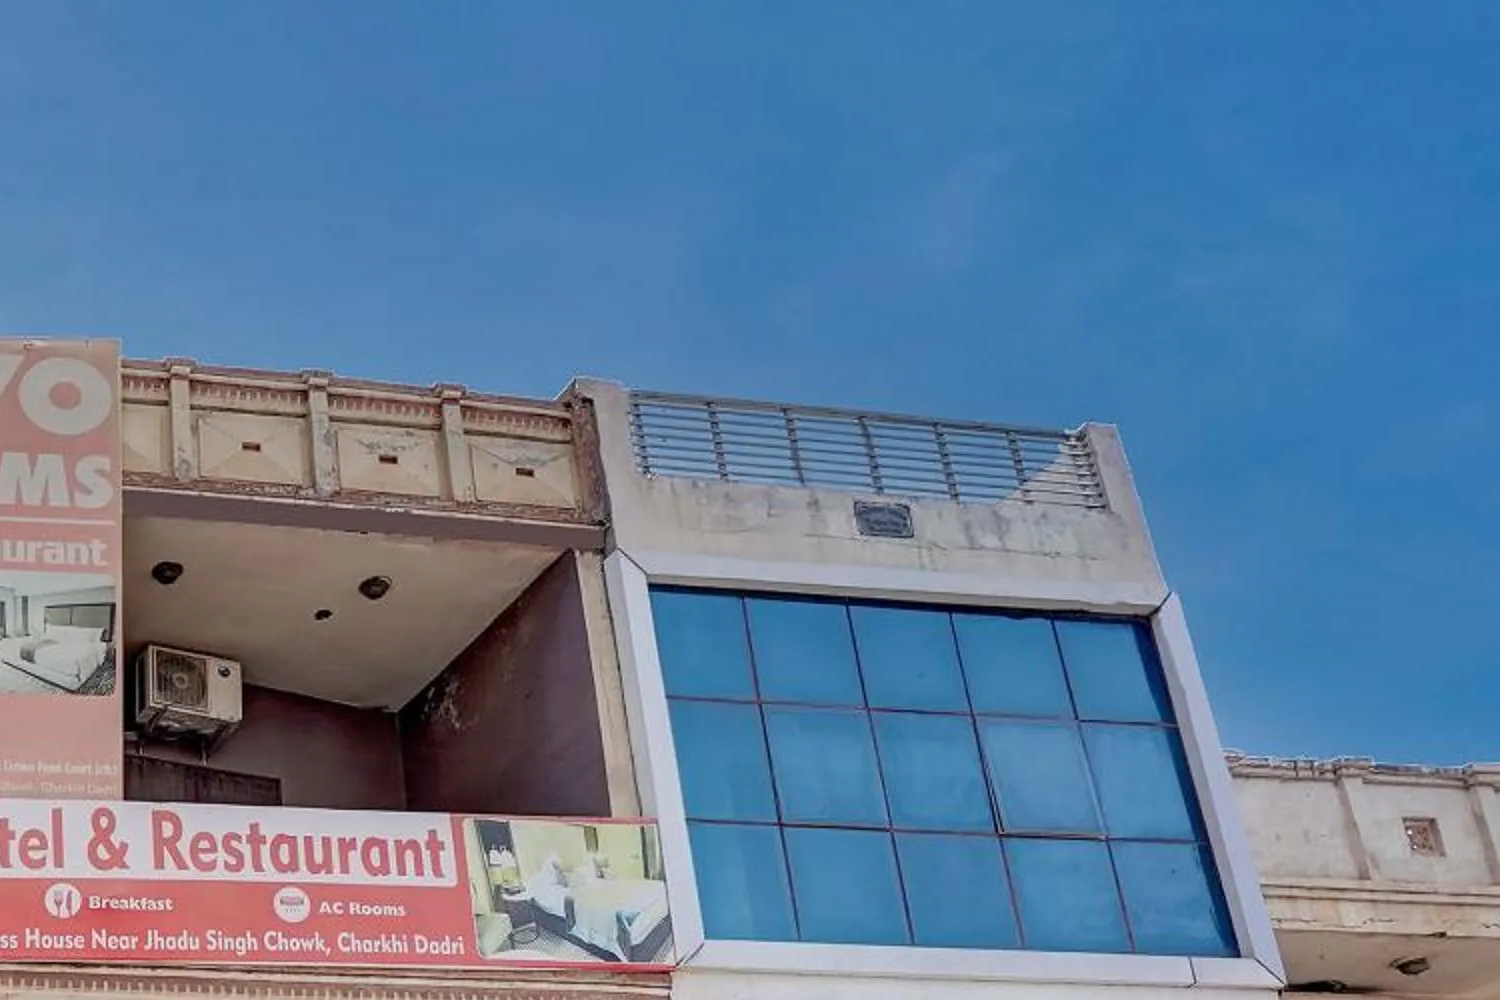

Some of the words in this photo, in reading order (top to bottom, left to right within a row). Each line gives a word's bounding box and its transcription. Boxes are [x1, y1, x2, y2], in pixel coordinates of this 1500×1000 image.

[87, 807, 130, 870] &
[151, 809, 445, 878] Restaurant
[88, 895, 174, 912] Breakfast
[319, 901, 344, 916] AC
[349, 902, 406, 918] Rooms
[25, 928, 85, 950] House
[91, 930, 140, 951] Near
[144, 930, 199, 952] Jhadu
[206, 930, 258, 955] Singh
[264, 931, 331, 956] Chowk,
[337, 934, 409, 954] Charkhi
[414, 935, 465, 956] Dadri
